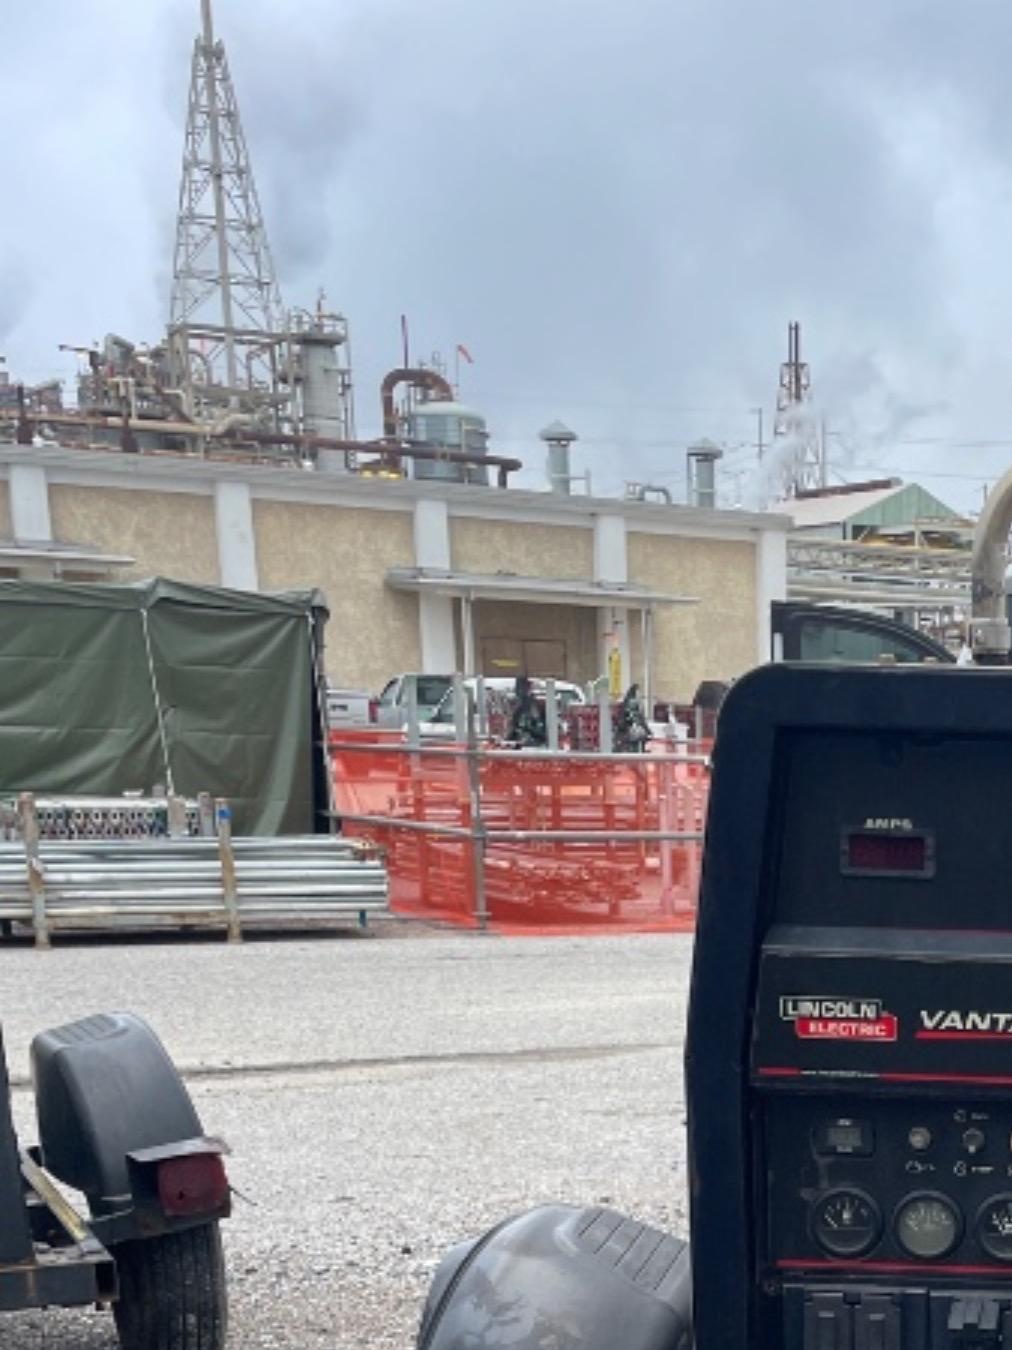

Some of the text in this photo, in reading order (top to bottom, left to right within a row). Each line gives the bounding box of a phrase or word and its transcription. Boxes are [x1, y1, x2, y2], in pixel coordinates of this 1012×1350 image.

[864, 817, 914, 830] AMPS
[786, 1000, 879, 1019] LINCOLN
[807, 1020, 889, 1037] ELECTRIC
